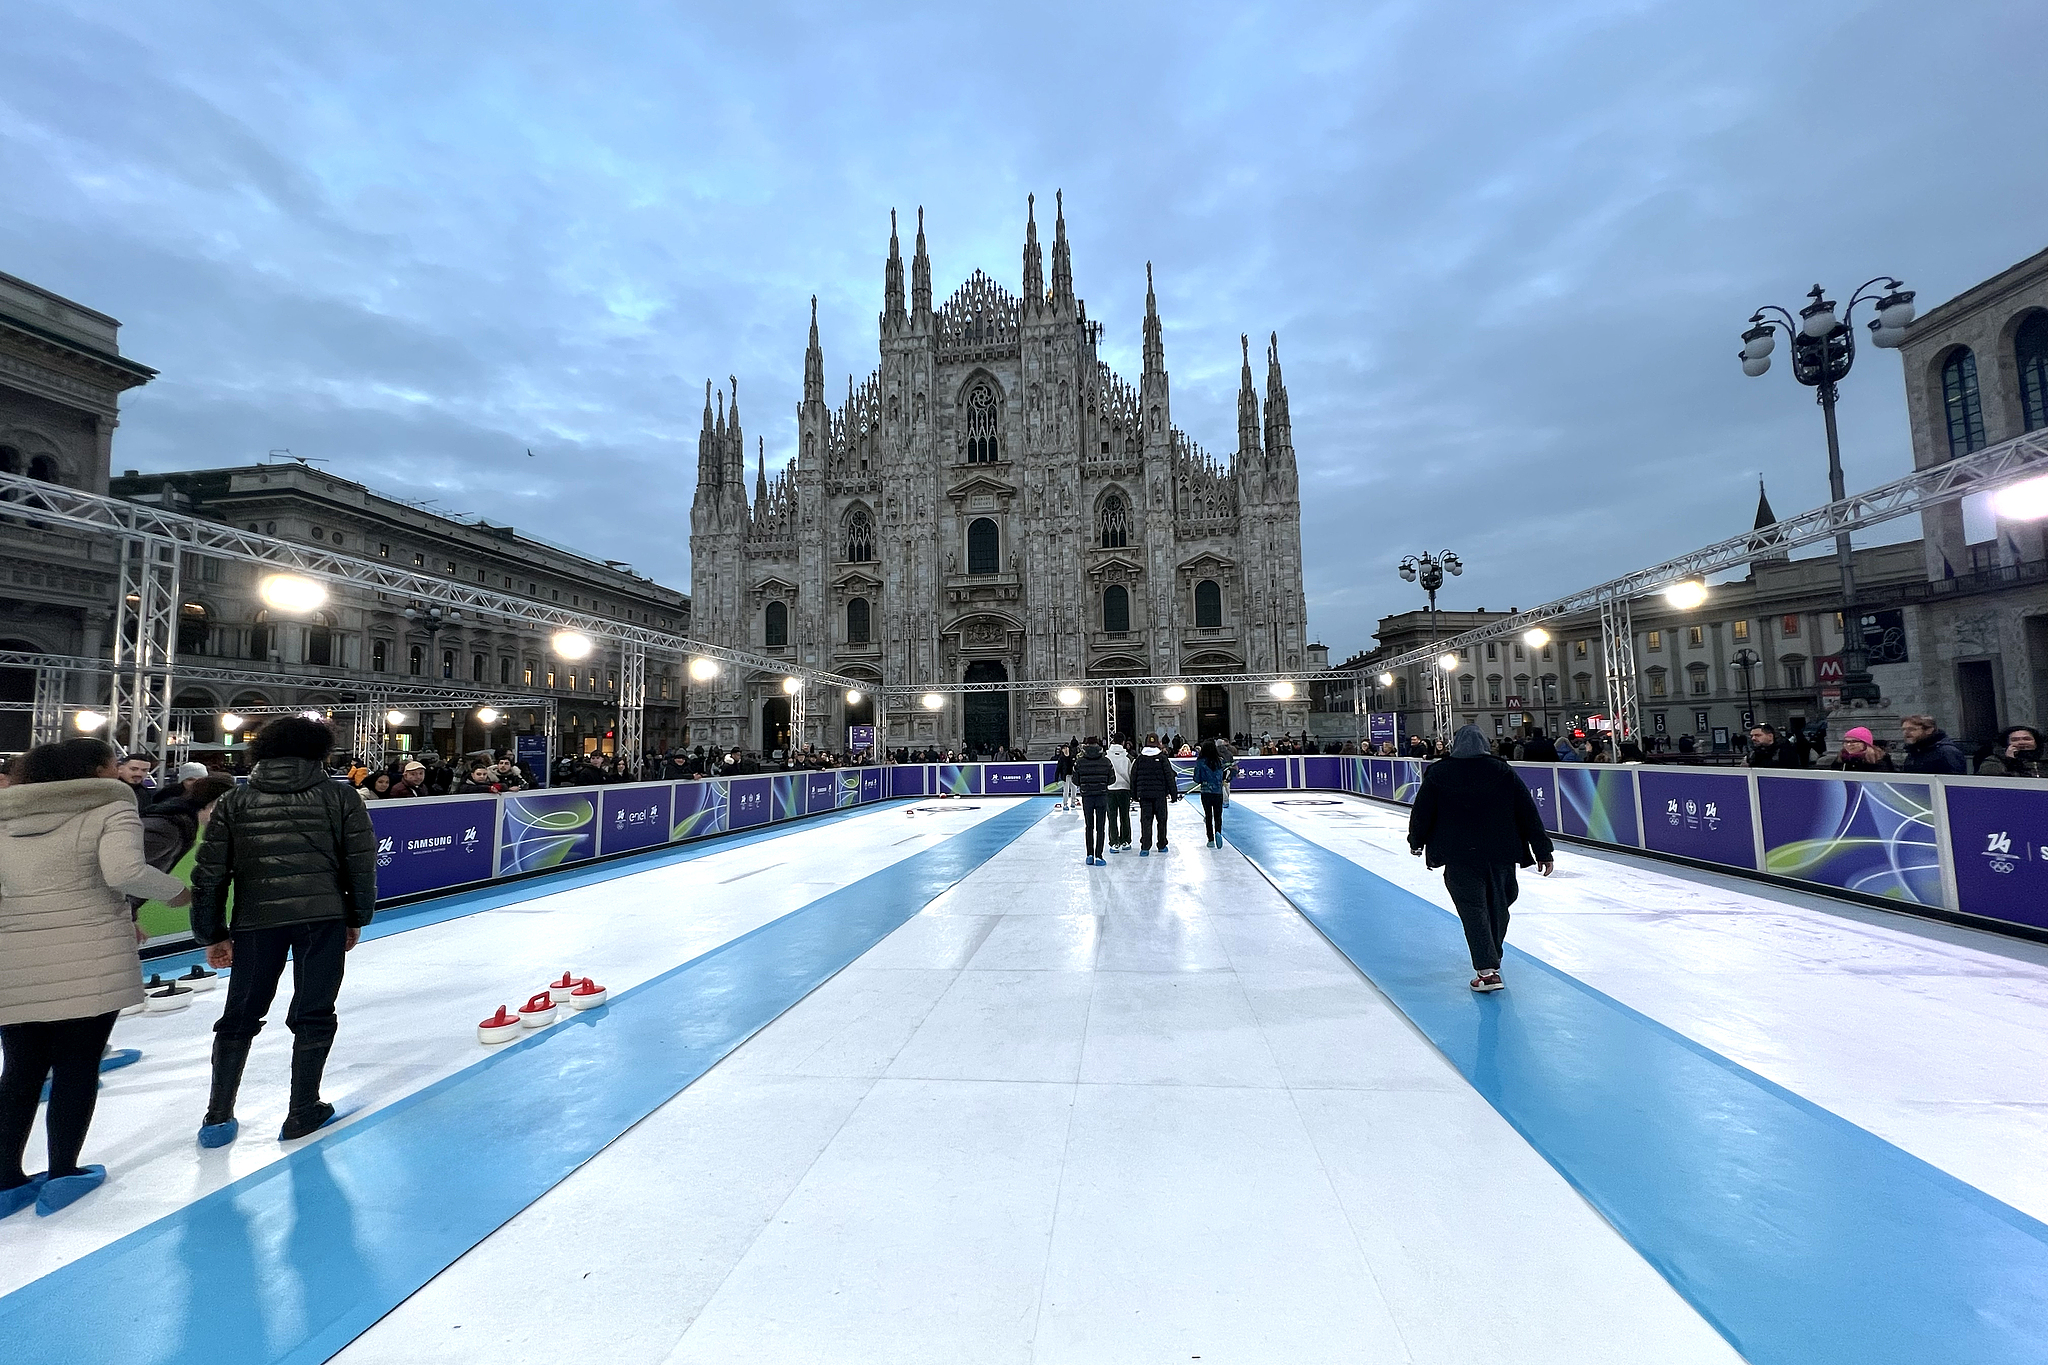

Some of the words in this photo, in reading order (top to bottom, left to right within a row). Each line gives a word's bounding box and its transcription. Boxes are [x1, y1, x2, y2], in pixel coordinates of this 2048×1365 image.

[1820, 661, 1843, 676] M
[1508, 699, 1521, 708] M
[407, 835, 453, 850] SAMSUNG
